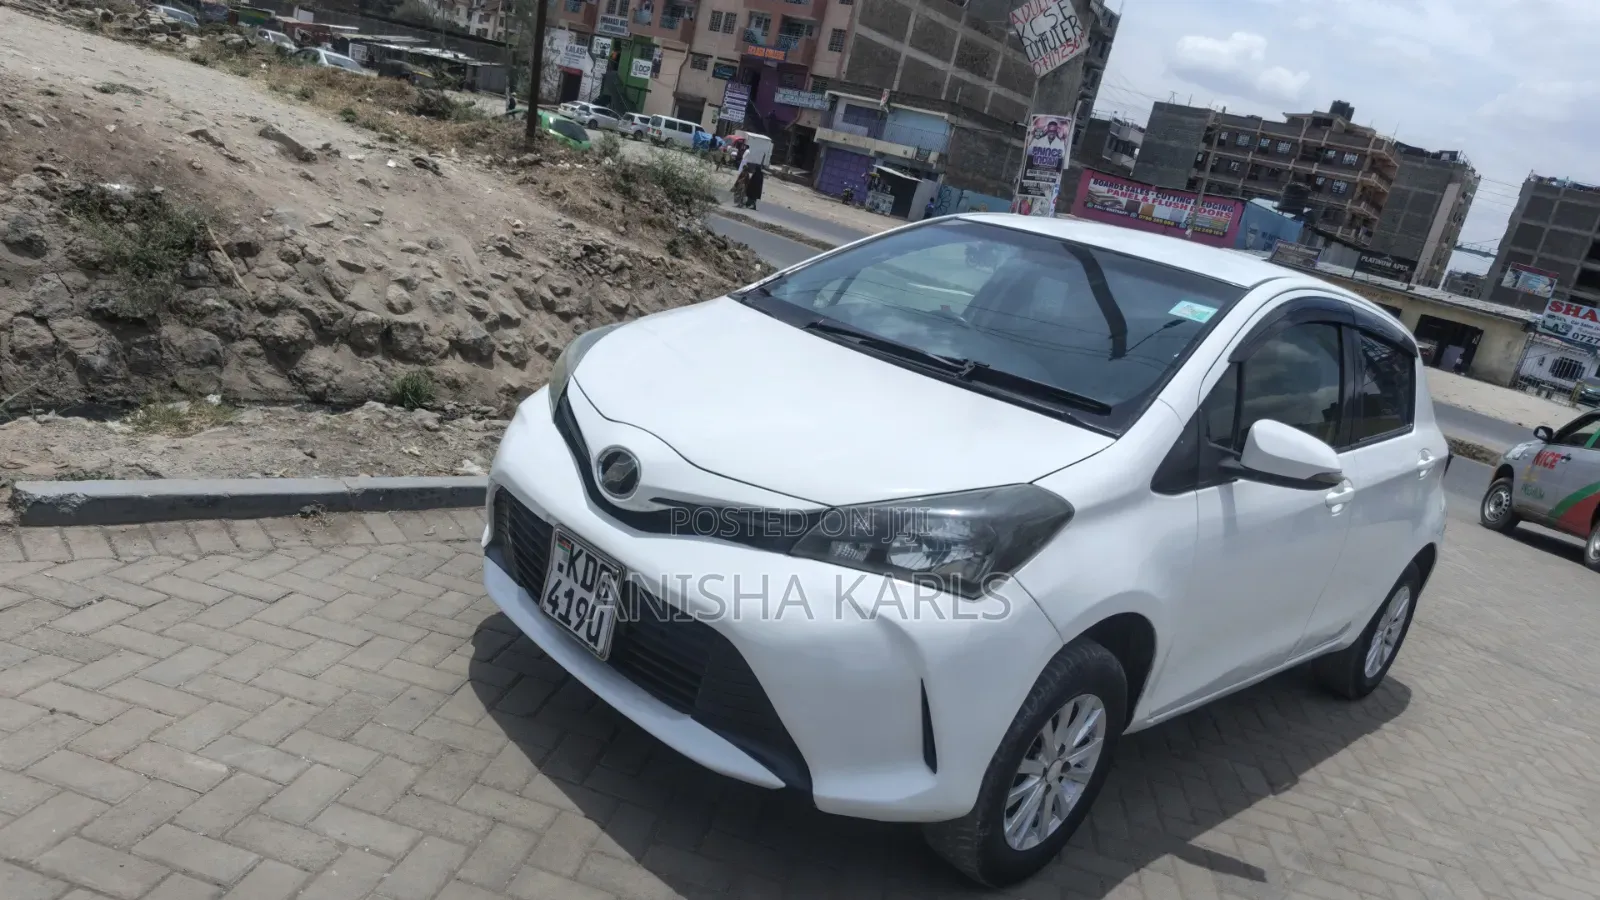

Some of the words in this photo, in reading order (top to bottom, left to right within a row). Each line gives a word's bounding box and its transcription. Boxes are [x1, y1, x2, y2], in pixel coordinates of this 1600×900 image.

[1024, 15, 1083, 63] COMPUTER
[639, 64, 650, 72] DCP
[1093, 179, 1124, 190] BOARDS
[1125, 185, 1150, 196] SALES
[1156, 192, 1192, 205] CUTTING
[1201, 200, 1234, 213] EDGING
[1107, 188, 1140, 201] PANEL
[1151, 198, 1188, 211] FLUSH
[1361, 255, 1392, 268] PLATINUM
[1393, 262, 1410, 272] APEX
[1548, 300, 1600, 323] SHA
[1532, 449, 1562, 470] NICE
